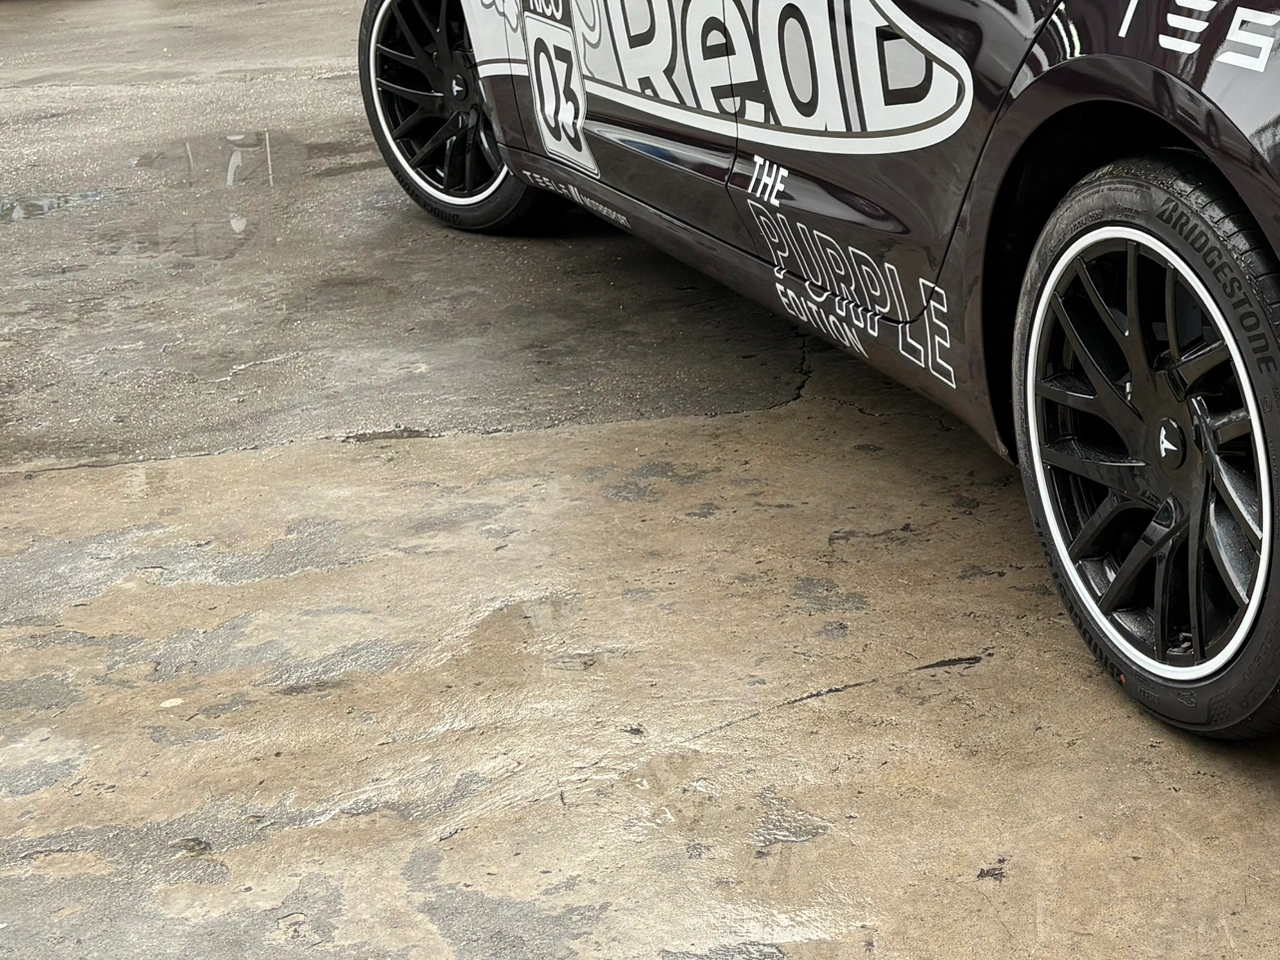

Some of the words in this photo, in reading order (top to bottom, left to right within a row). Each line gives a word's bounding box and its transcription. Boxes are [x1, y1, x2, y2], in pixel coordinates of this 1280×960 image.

[533, 37, 583, 153] 03
[747, 154, 789, 207] THE
[747, 199, 956, 389] PURPLE
[775, 282, 869, 359] EDITION
[1156, 196, 1278, 375] BRIDGESTONE
